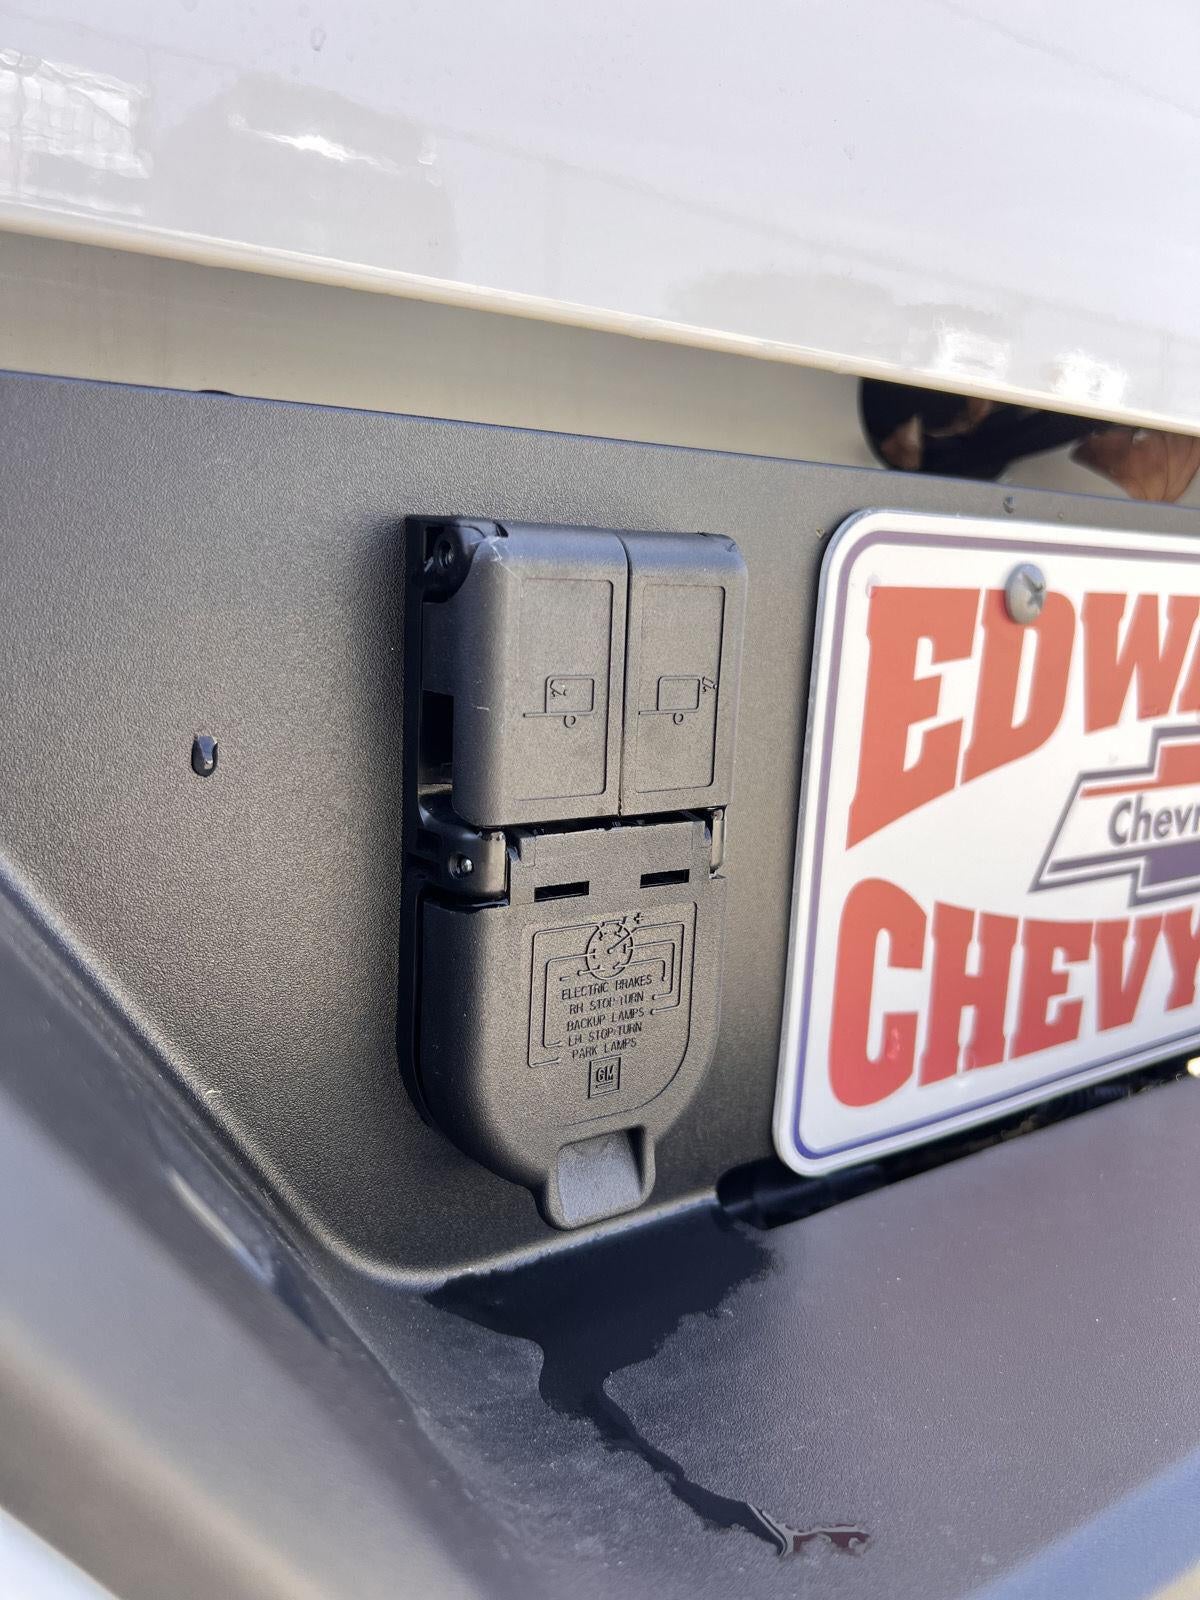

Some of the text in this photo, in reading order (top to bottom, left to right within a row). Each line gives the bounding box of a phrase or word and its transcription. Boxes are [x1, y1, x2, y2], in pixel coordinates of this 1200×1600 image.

[846, 584, 1200, 852] EDW
[562, 974, 652, 1000] ELECTRIC BRAKES
[567, 1007, 644, 1031] BACKUP LAMPS
[569, 1002, 584, 1015] RH
[568, 1034, 582, 1047] LH
[572, 1038, 637, 1059] PARK LAMPS
[595, 1064, 614, 1083] GM
